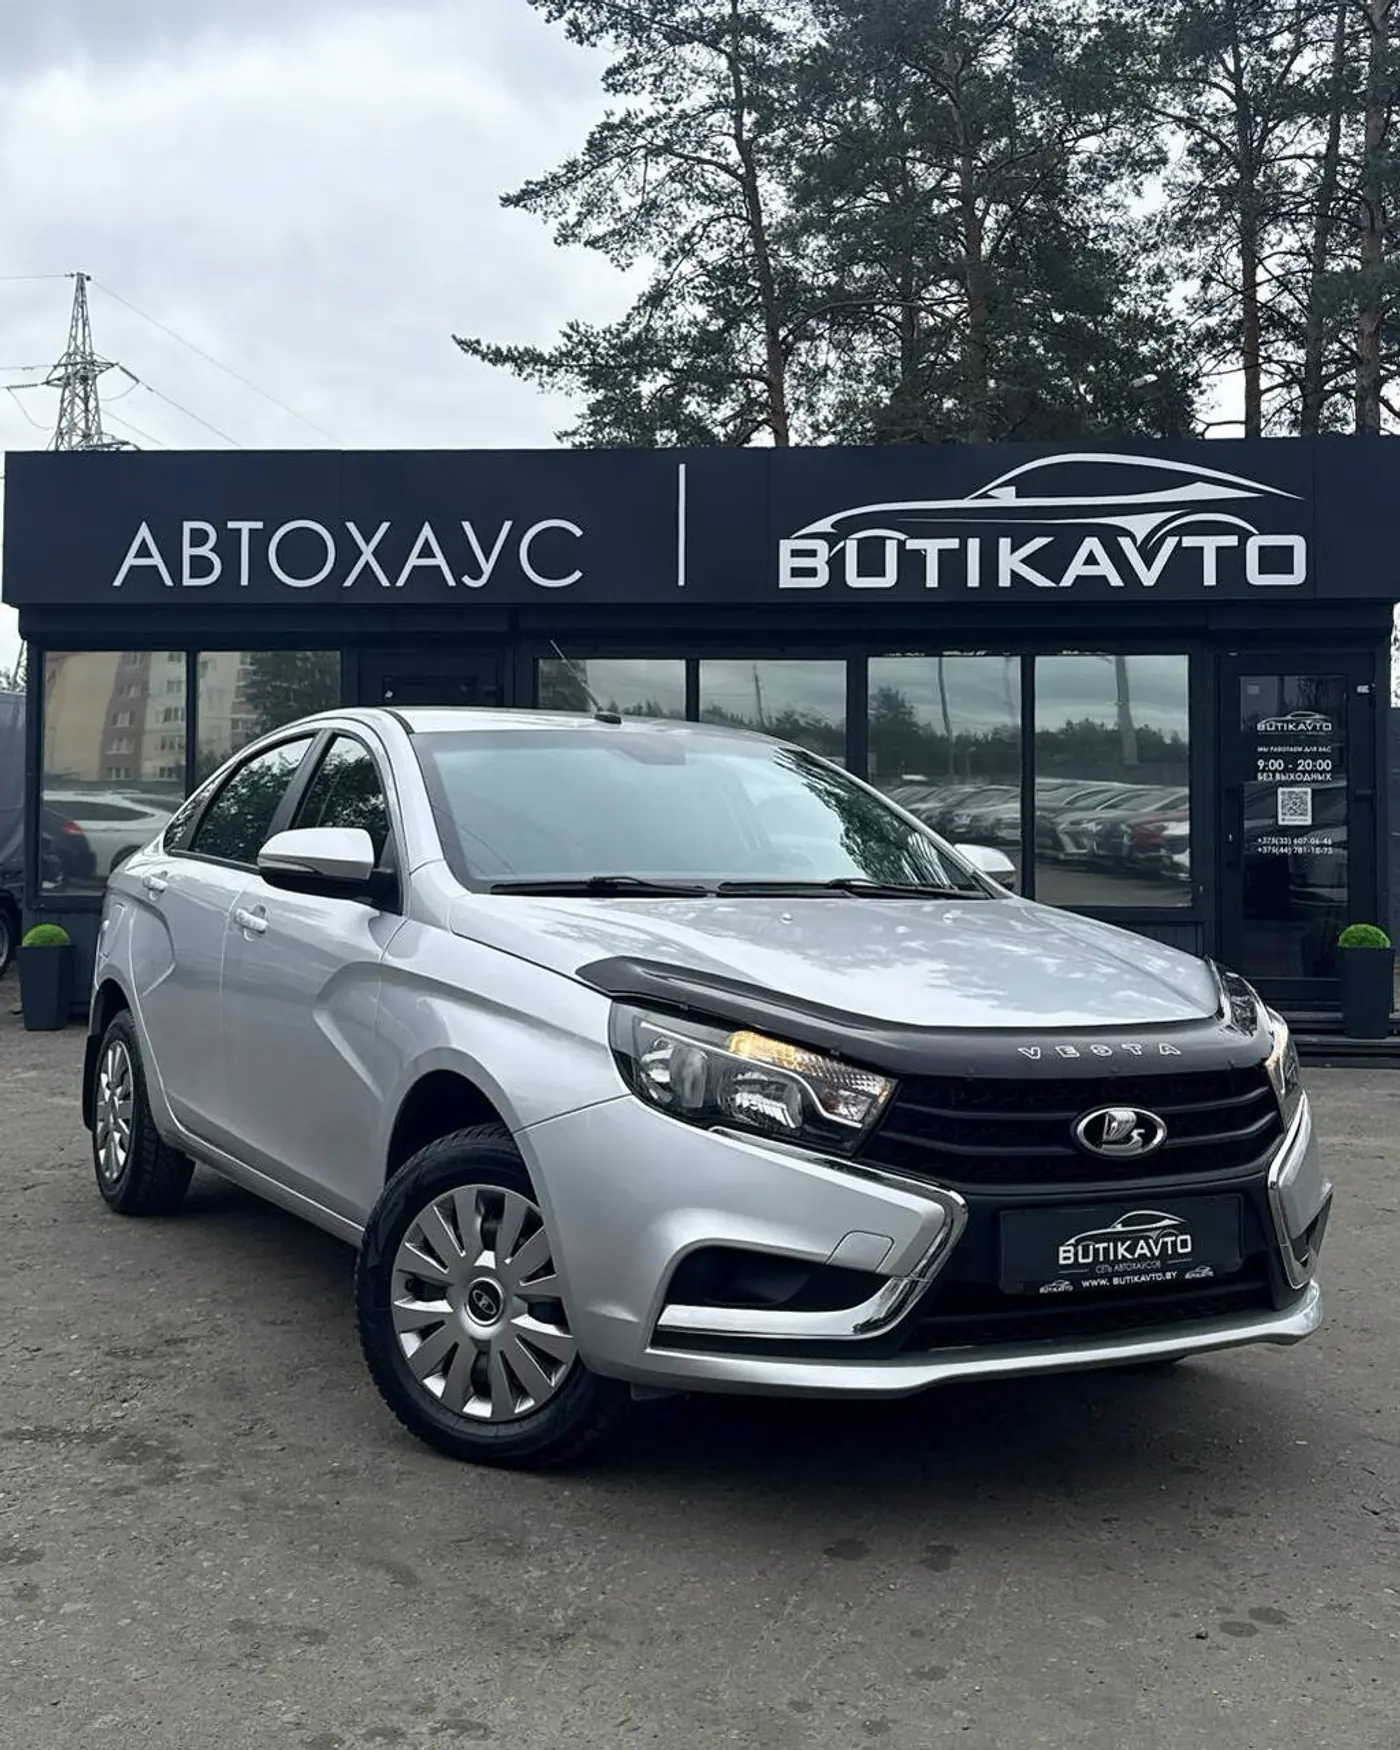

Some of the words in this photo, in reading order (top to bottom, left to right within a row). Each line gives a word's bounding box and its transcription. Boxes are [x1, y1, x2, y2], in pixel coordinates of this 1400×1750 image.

[113, 518, 585, 588] АВТОХАУС
[778, 534, 1307, 589] BUTIKAVTO
[1256, 722, 1332, 731] BUTIKAVTO
[1257, 759, 1284, 770] 9:00
[1297, 759, 1332, 771] 20:00
[1257, 772, 1273, 781] БЕЗ
[1275, 772, 1332, 781] ВЫХОДНЫХ
[1017, 1043, 1181, 1059] VESTA
[1058, 1234, 1192, 1265] BUTIKAVTO
[1081, 1278, 1110, 1288] WWW.
[1112, 1271, 1177, 1286] BUTIKAVTO.BY
